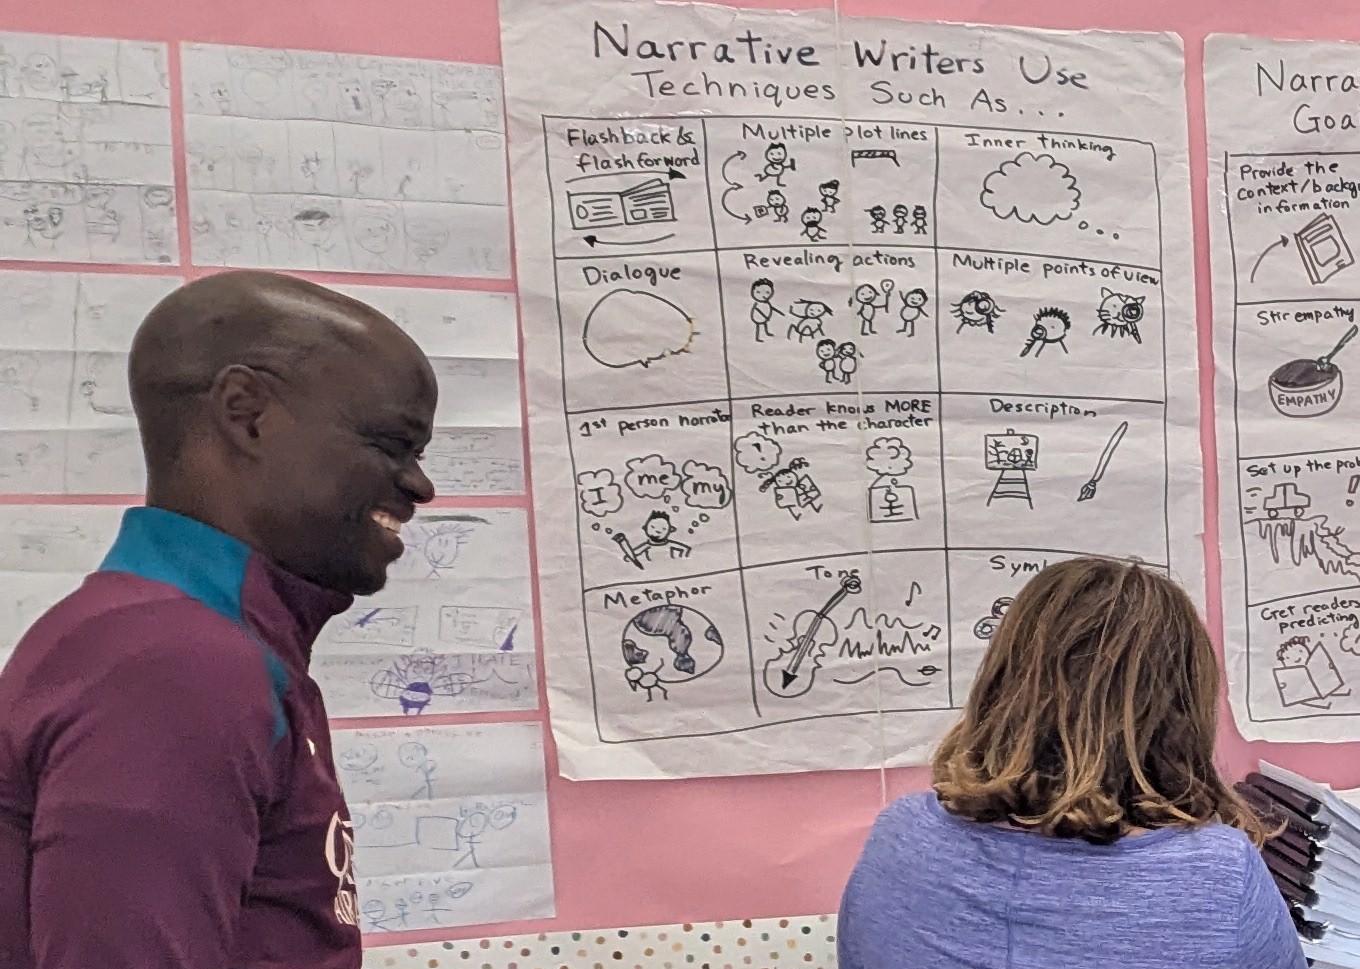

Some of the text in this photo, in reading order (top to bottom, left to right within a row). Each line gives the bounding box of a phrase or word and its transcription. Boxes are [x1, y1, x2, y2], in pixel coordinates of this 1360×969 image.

[594, 21, 1090, 91] Narrative Writers Use
[631, 70, 836, 107] Techniques
[870, 81, 946, 108] Such
[742, 122, 831, 140] Multiple
[890, 126, 928, 141] lines
[965, 133, 1117, 161] Inner thinking
[1240, 161, 1339, 181] Provide the
[1258, 198, 1350, 214] information
[744, 250, 916, 272] Revealing actions
[953, 253, 1160, 286] Multiple points of view
[582, 264, 682, 286] Dialogue
[1256, 304, 1356, 326] Stir empathy
[1277, 386, 1337, 408] EMPATHY
[751, 403, 816, 418] Reader
[885, 400, 931, 413] MORE
[990, 398, 1098, 419] Description
[618, 416, 669, 435] person
[758, 415, 934, 436] than the character
[1246, 464, 1278, 477] Set
[1282, 462, 1302, 477] up
[1306, 459, 1333, 473] the
[638, 472, 670, 486] me
[692, 482, 726, 505] my
[805, 565, 861, 582] Tone
[603, 582, 712, 610] Metaphor
[1260, 605, 1299, 622] Get
[1279, 613, 1360, 633] predicting
